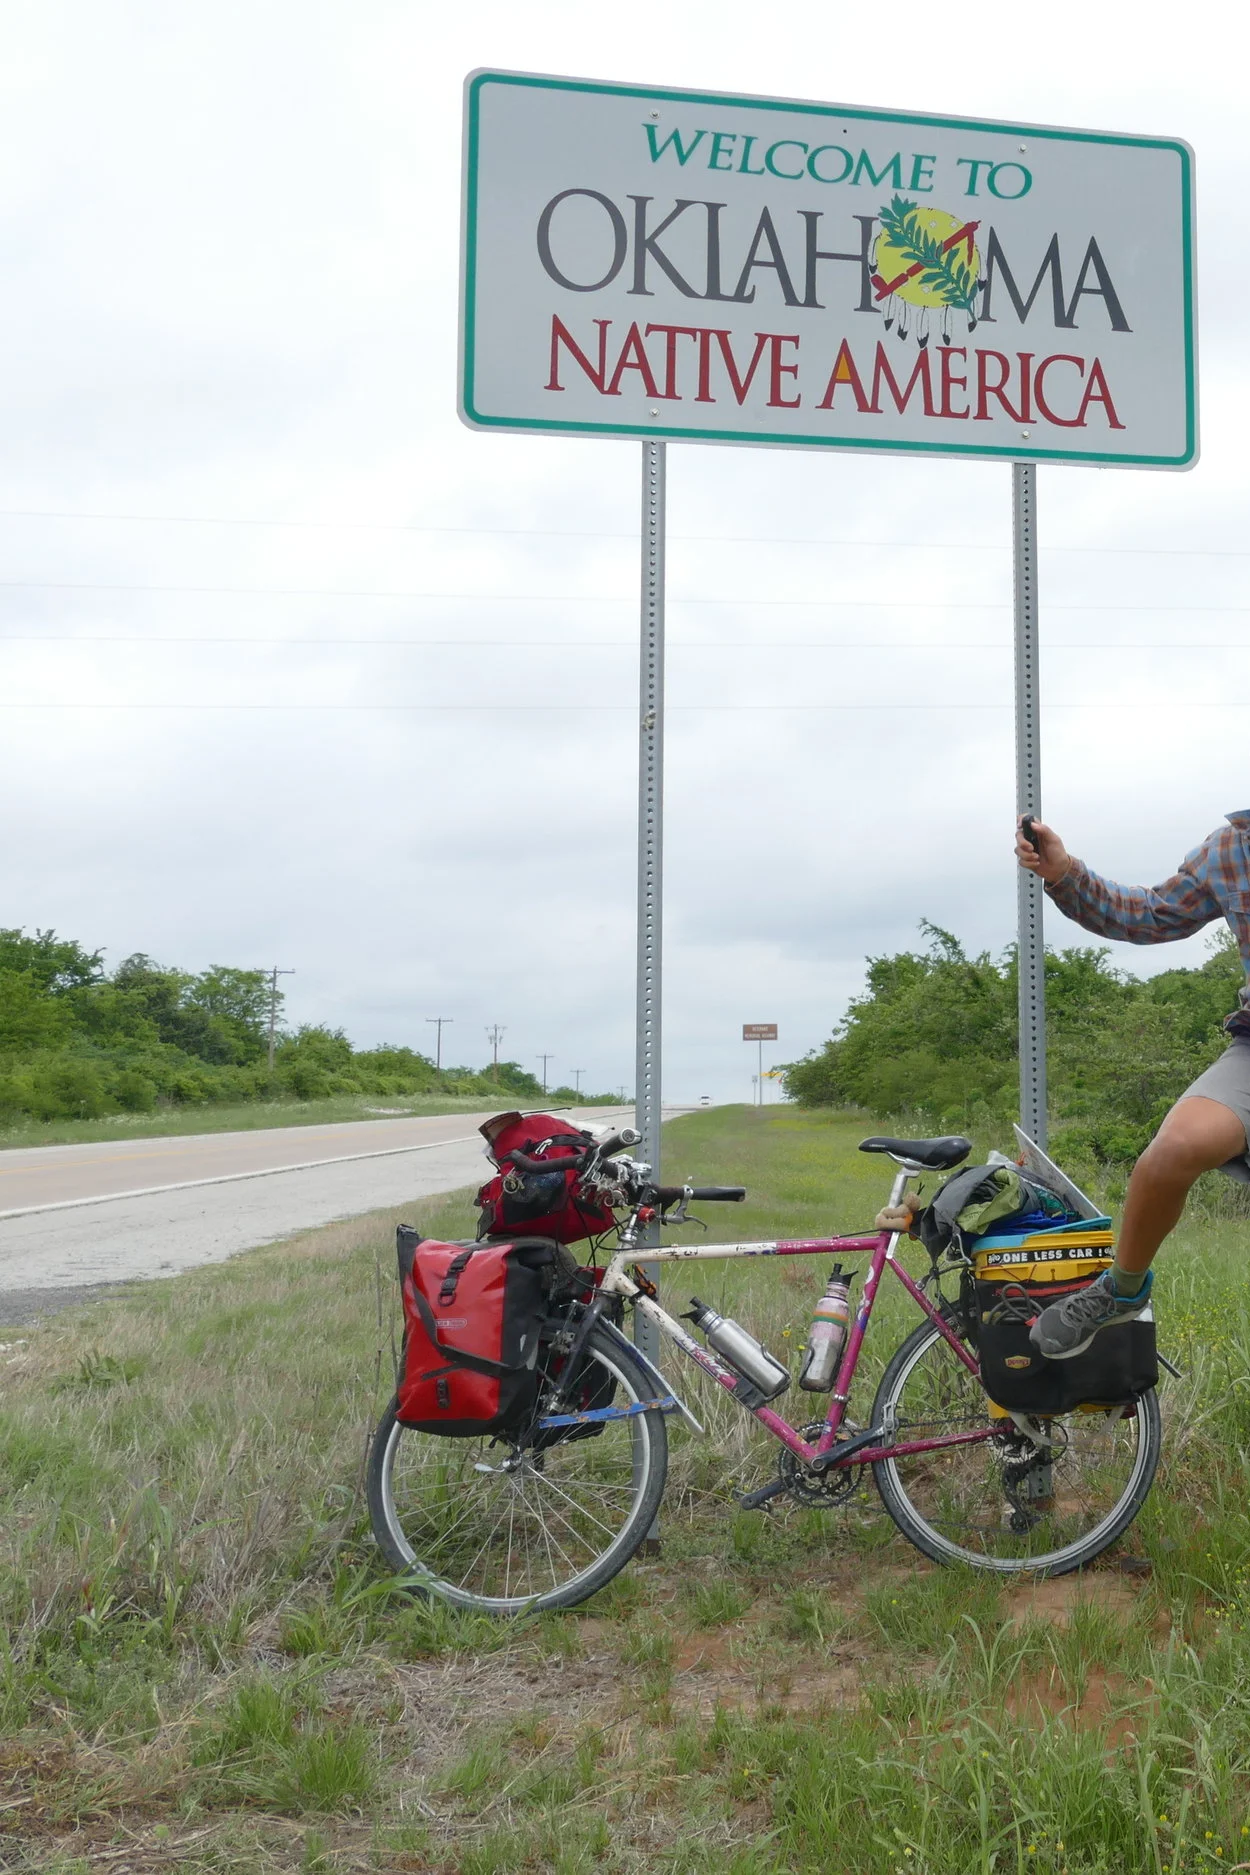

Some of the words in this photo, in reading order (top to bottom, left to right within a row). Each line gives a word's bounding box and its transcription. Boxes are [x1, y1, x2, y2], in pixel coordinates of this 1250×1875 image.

[642, 123, 937, 194] WELCOME
[957, 158, 1033, 200] TO
[543, 314, 801, 409] NATIVE
[816, 339, 1126, 430] AMERICA
[1003, 1252, 1028, 1263] ONE
[1034, 1250, 1063, 1261] LESS
[1069, 1248, 1093, 1259] CAR
